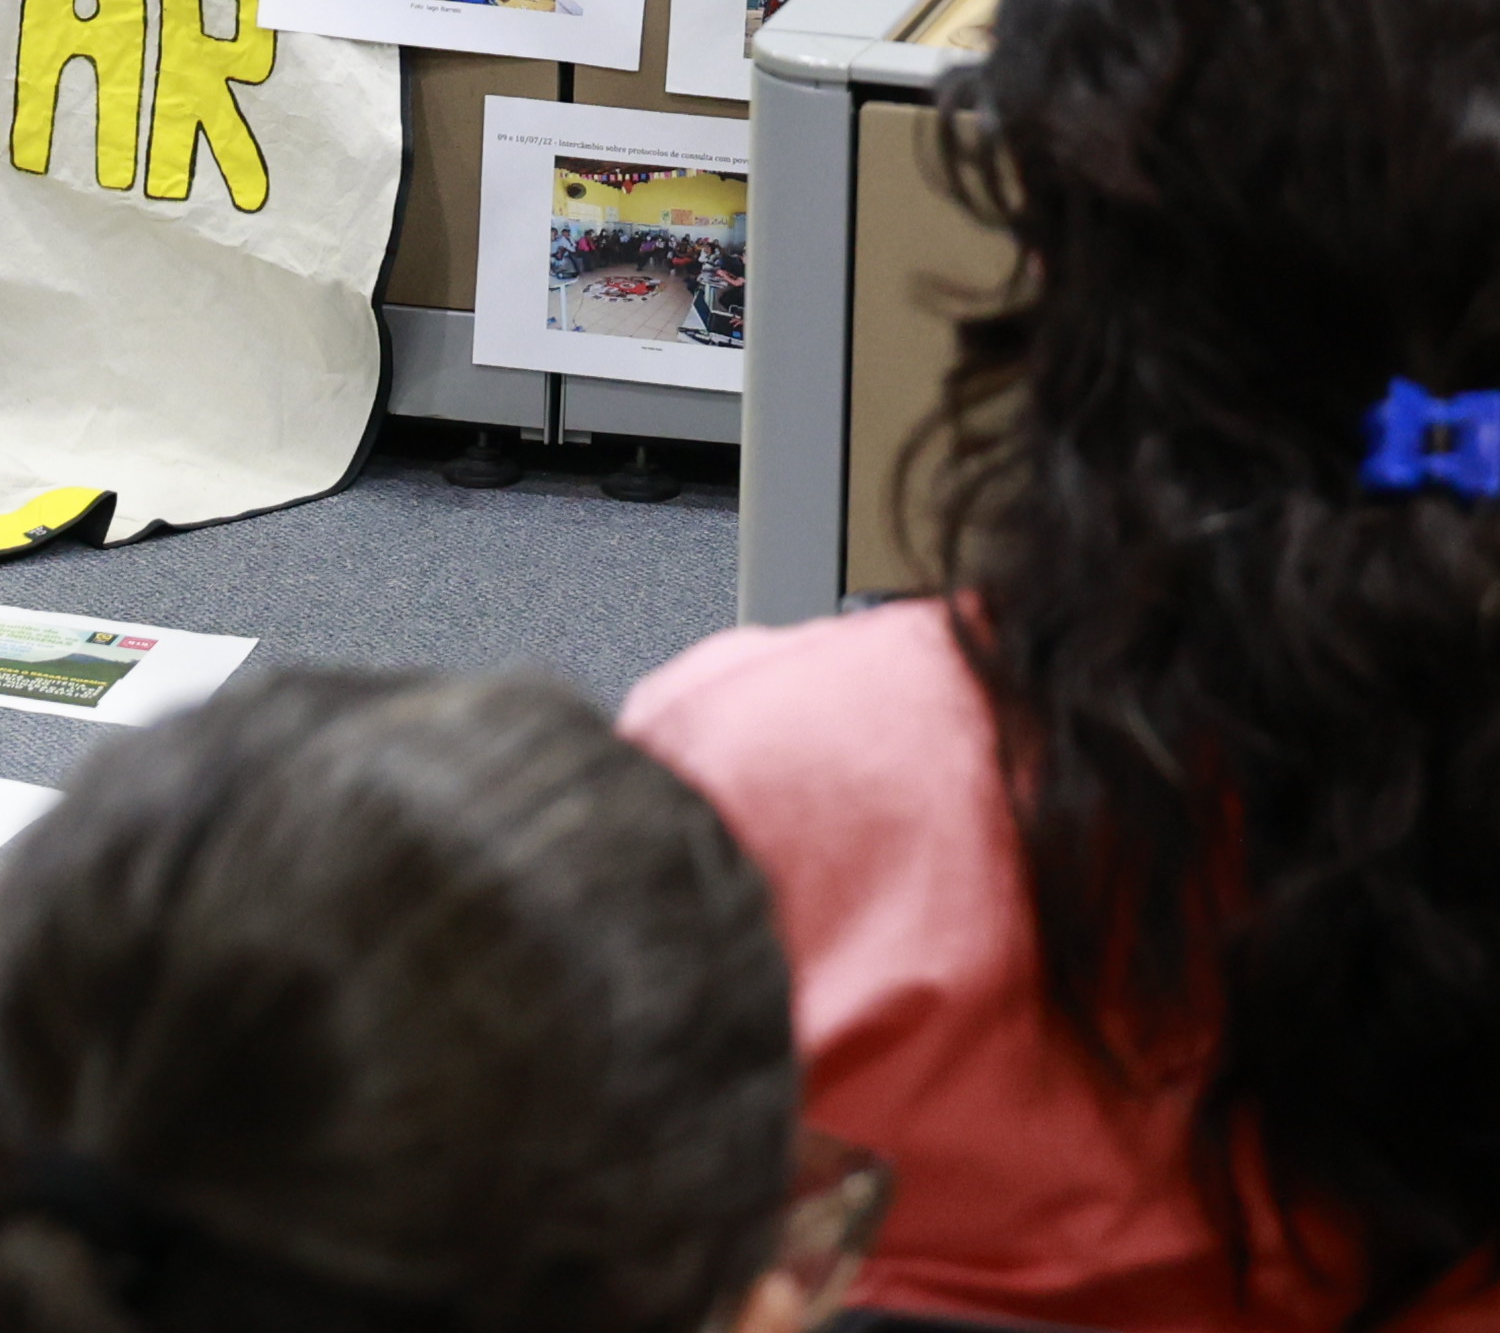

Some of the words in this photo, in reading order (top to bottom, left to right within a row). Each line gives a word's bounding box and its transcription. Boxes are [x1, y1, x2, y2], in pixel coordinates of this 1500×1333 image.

[497, 133, 507, 141] 09
[558, 139, 604, 151] Intercâmbio
[605, 143, 627, 154] sobre
[628, 145, 669, 158] protocolos
[670, 149, 680, 159] de
[681, 151, 713, 162] consulta
[714, 155, 731, 163] com
